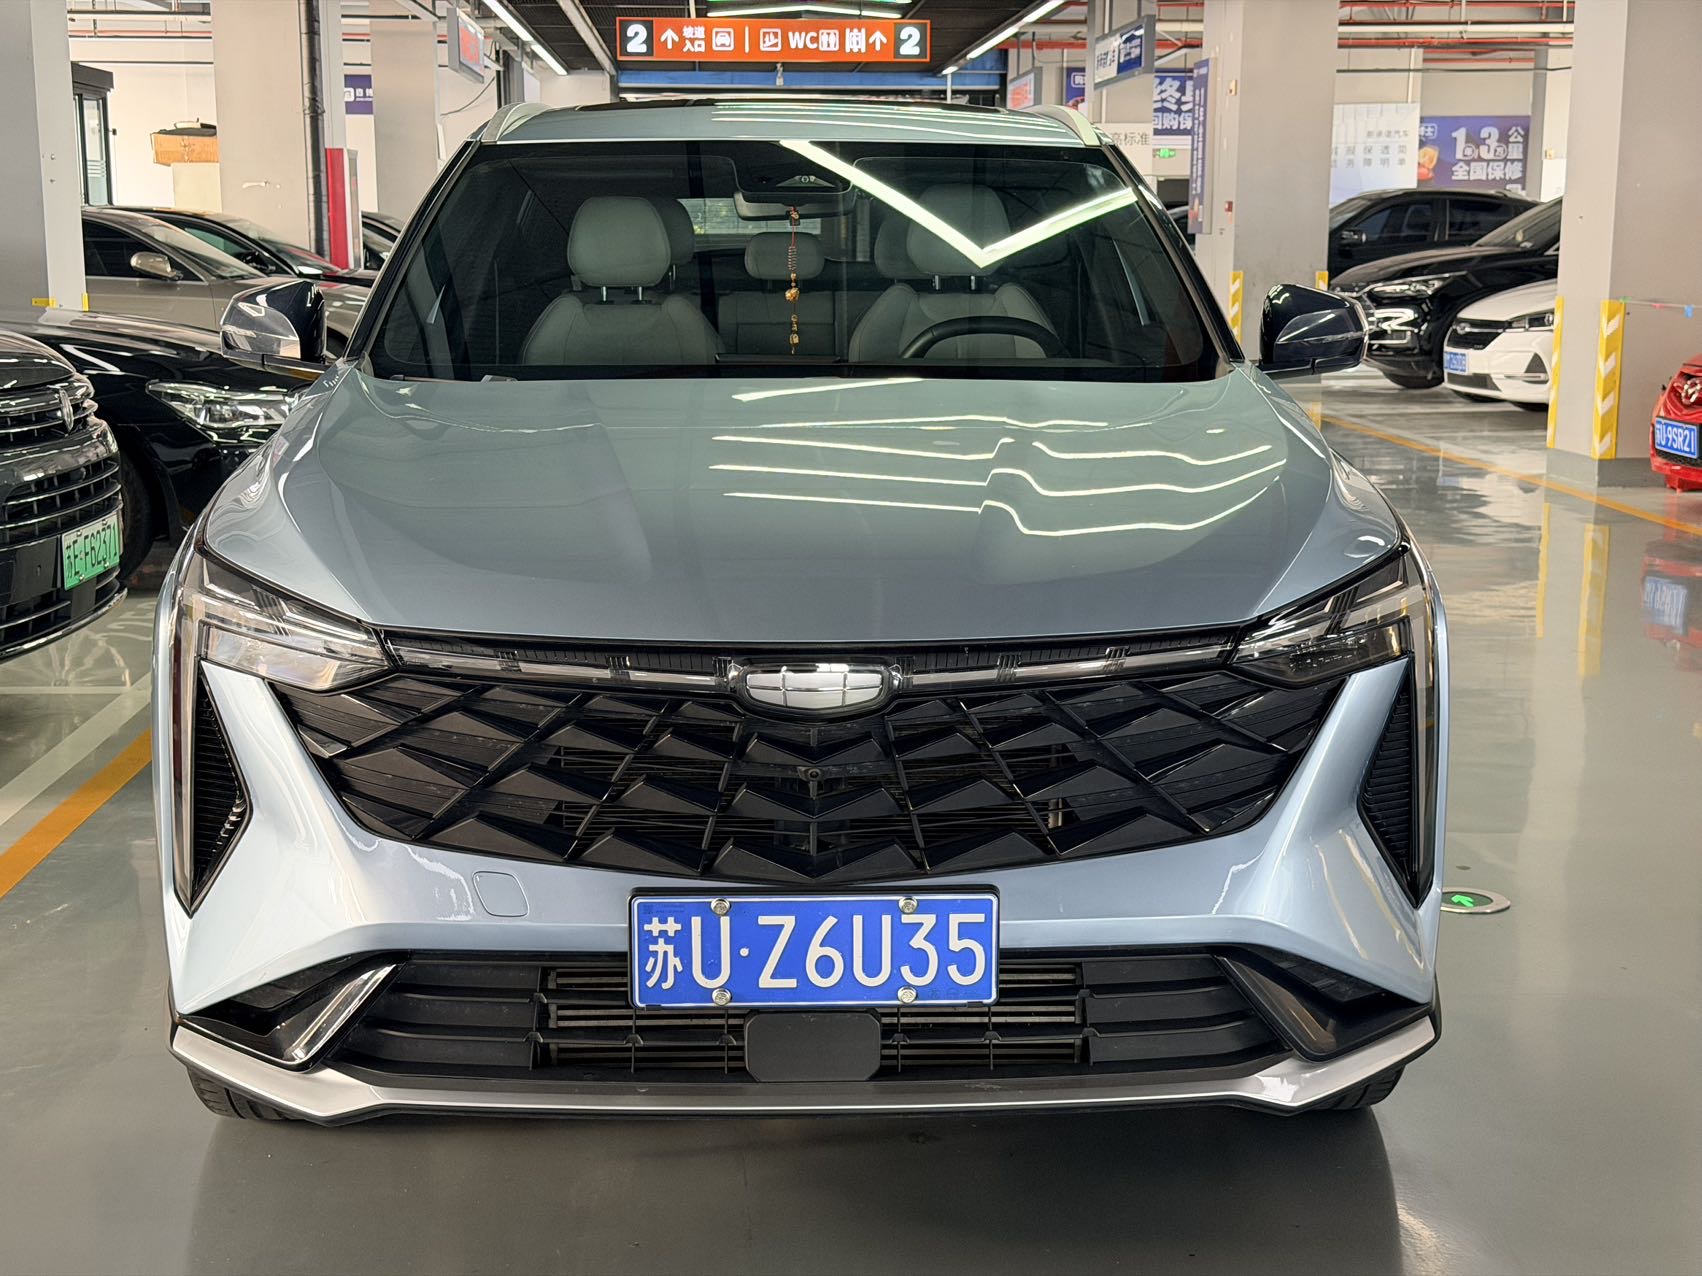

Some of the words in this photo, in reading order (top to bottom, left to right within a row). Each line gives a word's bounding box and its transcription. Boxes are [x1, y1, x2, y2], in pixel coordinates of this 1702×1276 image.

[626, 24, 647, 53] 2
[683, 39, 705, 52] 入口
[788, 31, 818, 49] WC
[900, 26, 920, 55] 2
[1452, 161, 1523, 180] 全国保修
[643, 914, 986, 990] 苏U·Z6U35
